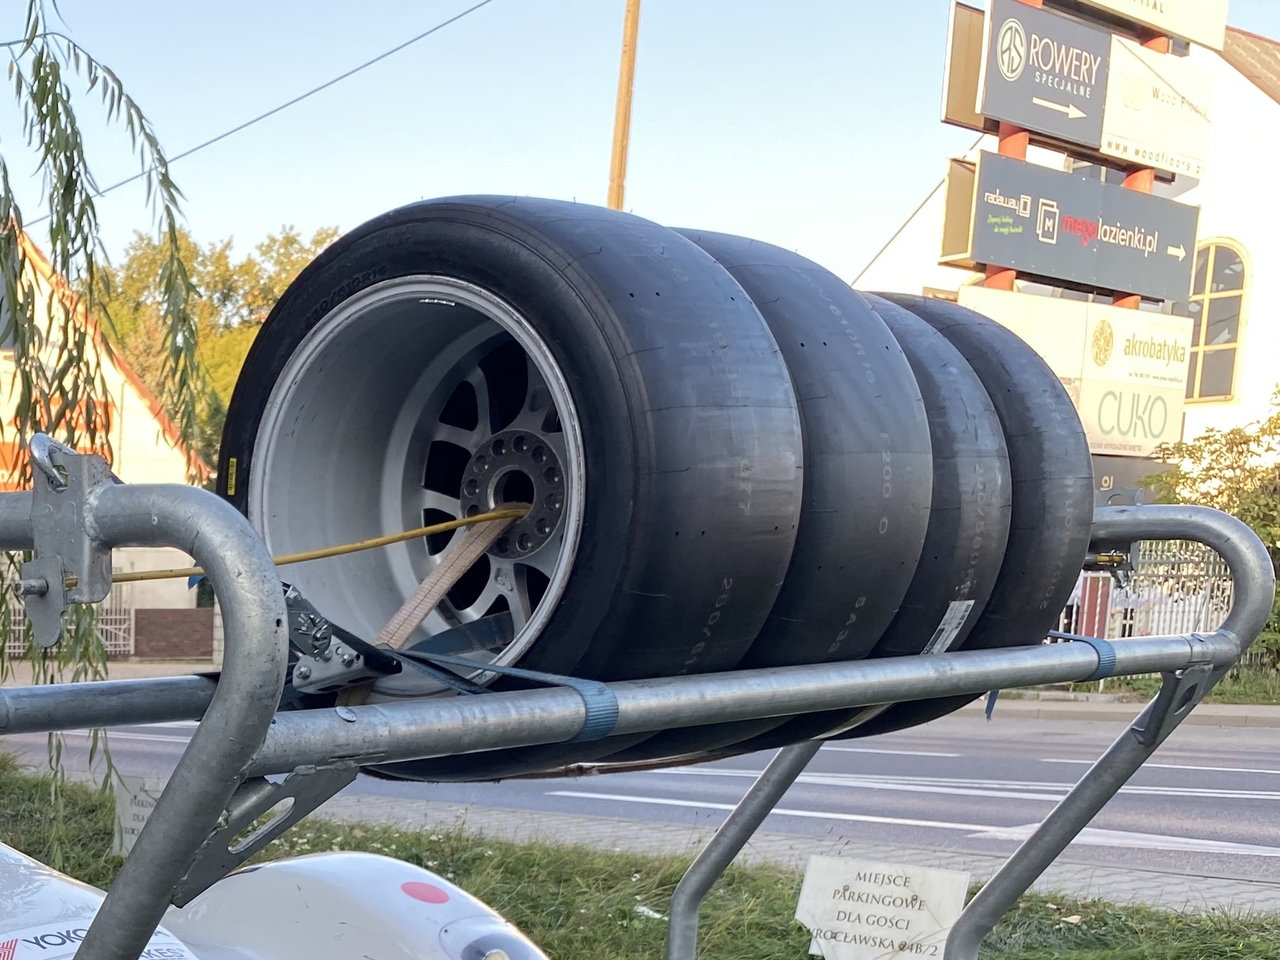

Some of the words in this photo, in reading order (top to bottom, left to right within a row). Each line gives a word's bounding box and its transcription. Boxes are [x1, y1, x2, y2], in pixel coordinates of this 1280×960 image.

[1029, 33, 1101, 85] ROWERY
[1034, 71, 1091, 98] SPECJALNE
[1062, 215, 1159, 257] megalazienki.pl
[1124, 332, 1186, 367] akrobatyka
[1098, 390, 1167, 439] CUKO
[854, 871, 911, 888] MIEJSCE
[832, 888, 926, 911] PARKINGOWE
[836, 910, 862, 924] DLA
[865, 914, 910, 931] GOŚCI
